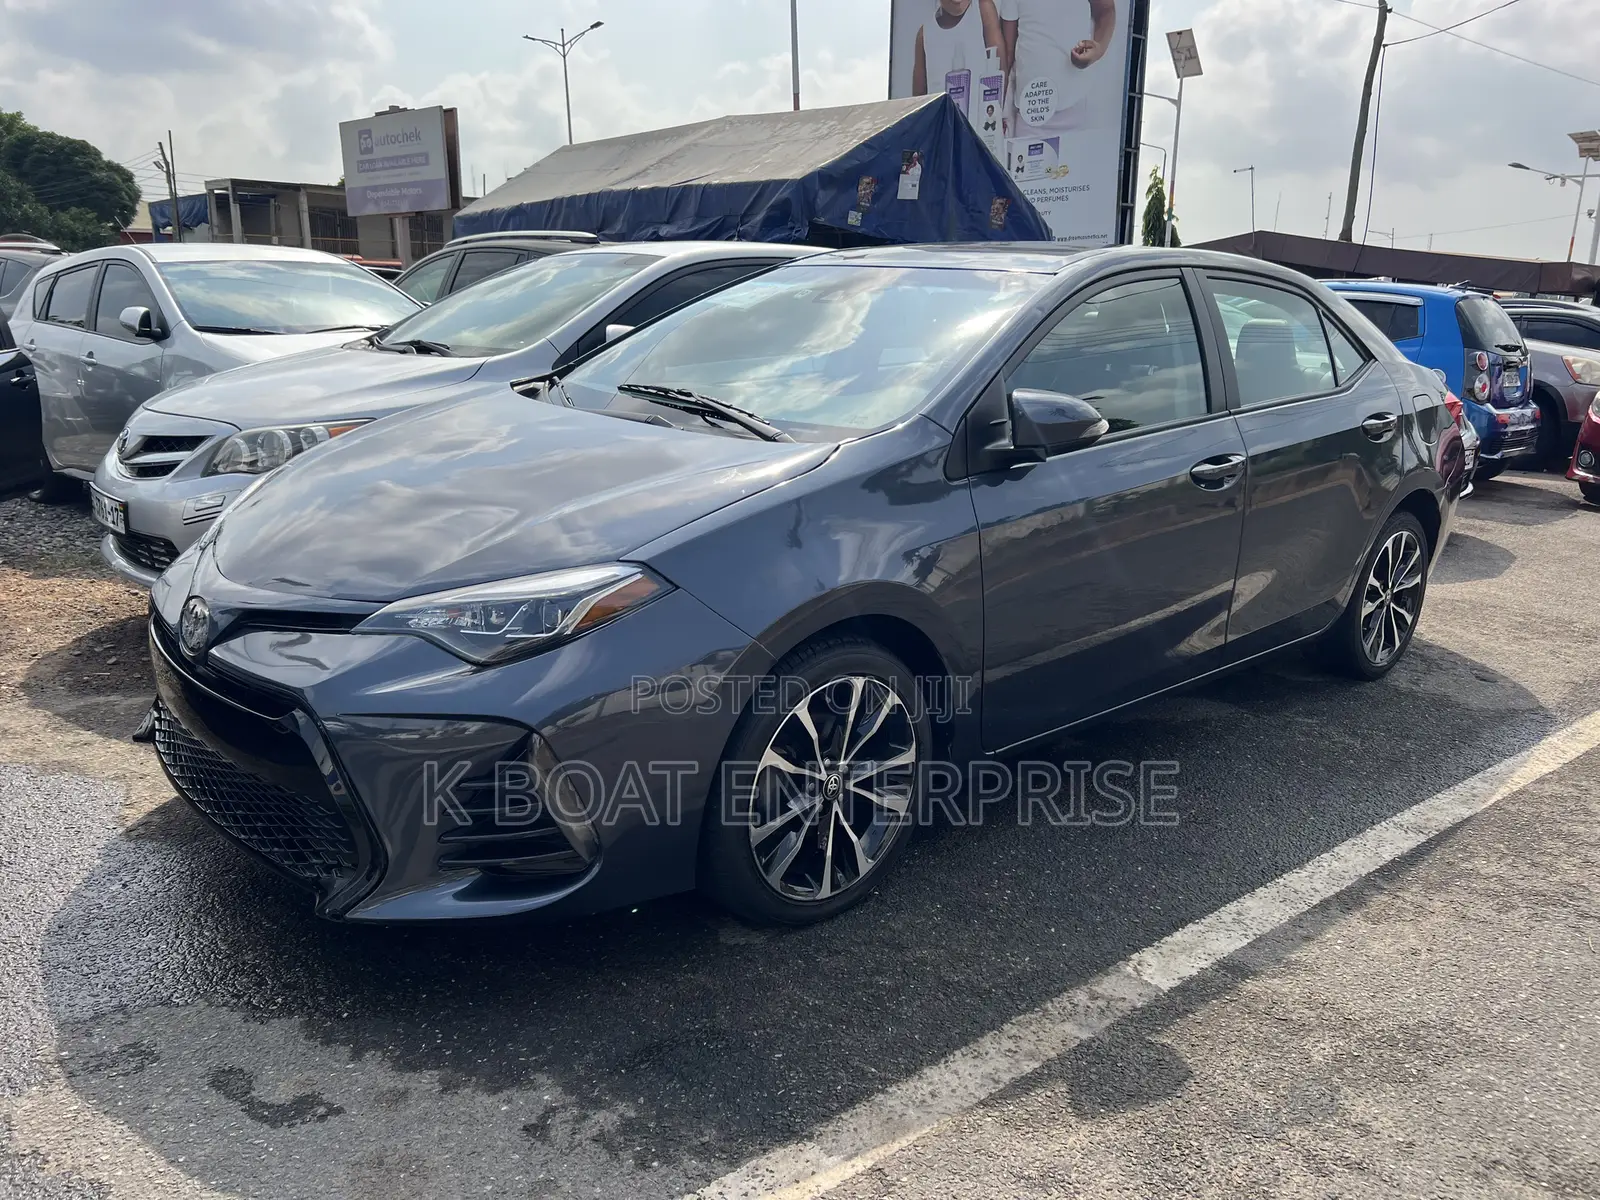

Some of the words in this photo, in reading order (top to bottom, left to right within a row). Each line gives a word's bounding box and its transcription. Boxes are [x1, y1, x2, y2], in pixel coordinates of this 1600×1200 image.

[1031, 81, 1048, 89] CARE
[1024, 89, 1053, 98] ADAPTED
[1026, 106, 1050, 114] CHILD'S
[1049, 185, 1090, 194] MOISTURISES
[1036, 195, 1069, 203] PERFUMES
